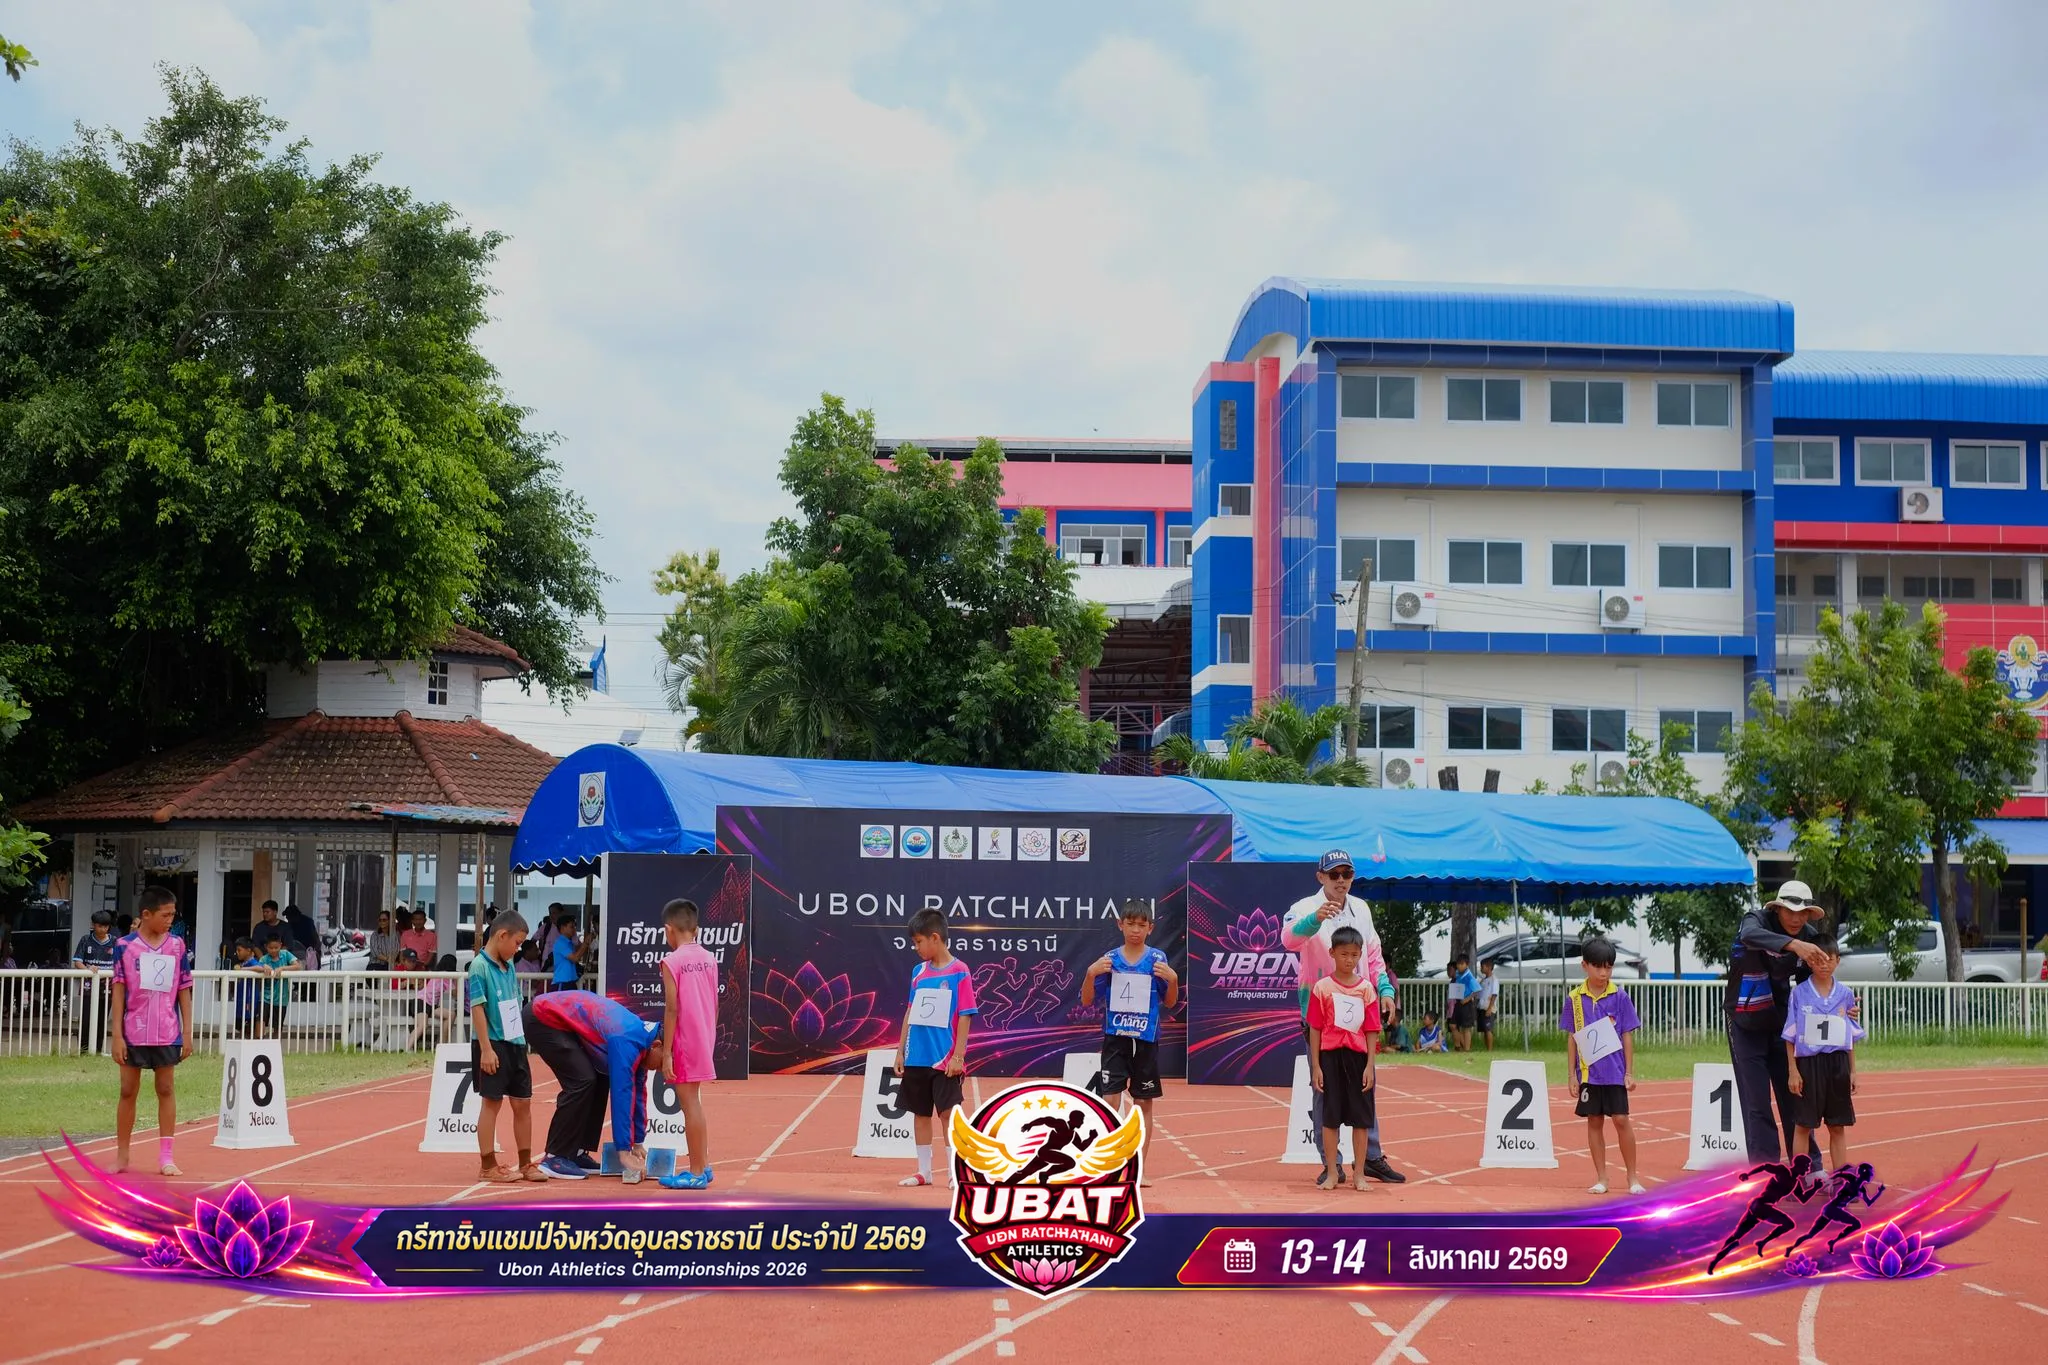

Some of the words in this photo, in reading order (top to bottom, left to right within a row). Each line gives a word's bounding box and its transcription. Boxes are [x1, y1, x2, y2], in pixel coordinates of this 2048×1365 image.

[1328, 852, 1348, 861] THAI
[798, 893, 905, 917] UBON
[925, 893, 1156, 920] RATCHATHAI
[153, 958, 167, 987] 8
[1209, 952, 1301, 975] UBON
[1119, 981, 1135, 1004] 4
[1212, 976, 1299, 989] ATHLETICS
[919, 996, 937, 1019] 5
[1342, 1001, 1356, 1025] 3
[1112, 1013, 1149, 1032] Chang
[1817, 1020, 1829, 1041] 1
[1587, 1028, 1608, 1055] 2
[226, 1057, 238, 1110] 8
[251, 1054, 274, 1108] 8
[445, 1061, 474, 1115] 7
[1101, 1069, 1111, 1084] 5
[652, 1069, 683, 1116] 6
[876, 1066, 908, 1120] 5
[1580, 1087, 1590, 1103] 6
[1501, 1078, 1535, 1131] 2
[1709, 1079, 1733, 1133] 1
[249, 1111, 276, 1127] Nelco
[438, 1117, 478, 1134] Nelco
[647, 1118, 686, 1135] Nelco
[870, 1121, 911, 1139] Nelco
[1496, 1134, 1536, 1151] Nelco
[1700, 1134, 1738, 1151] Nelco
